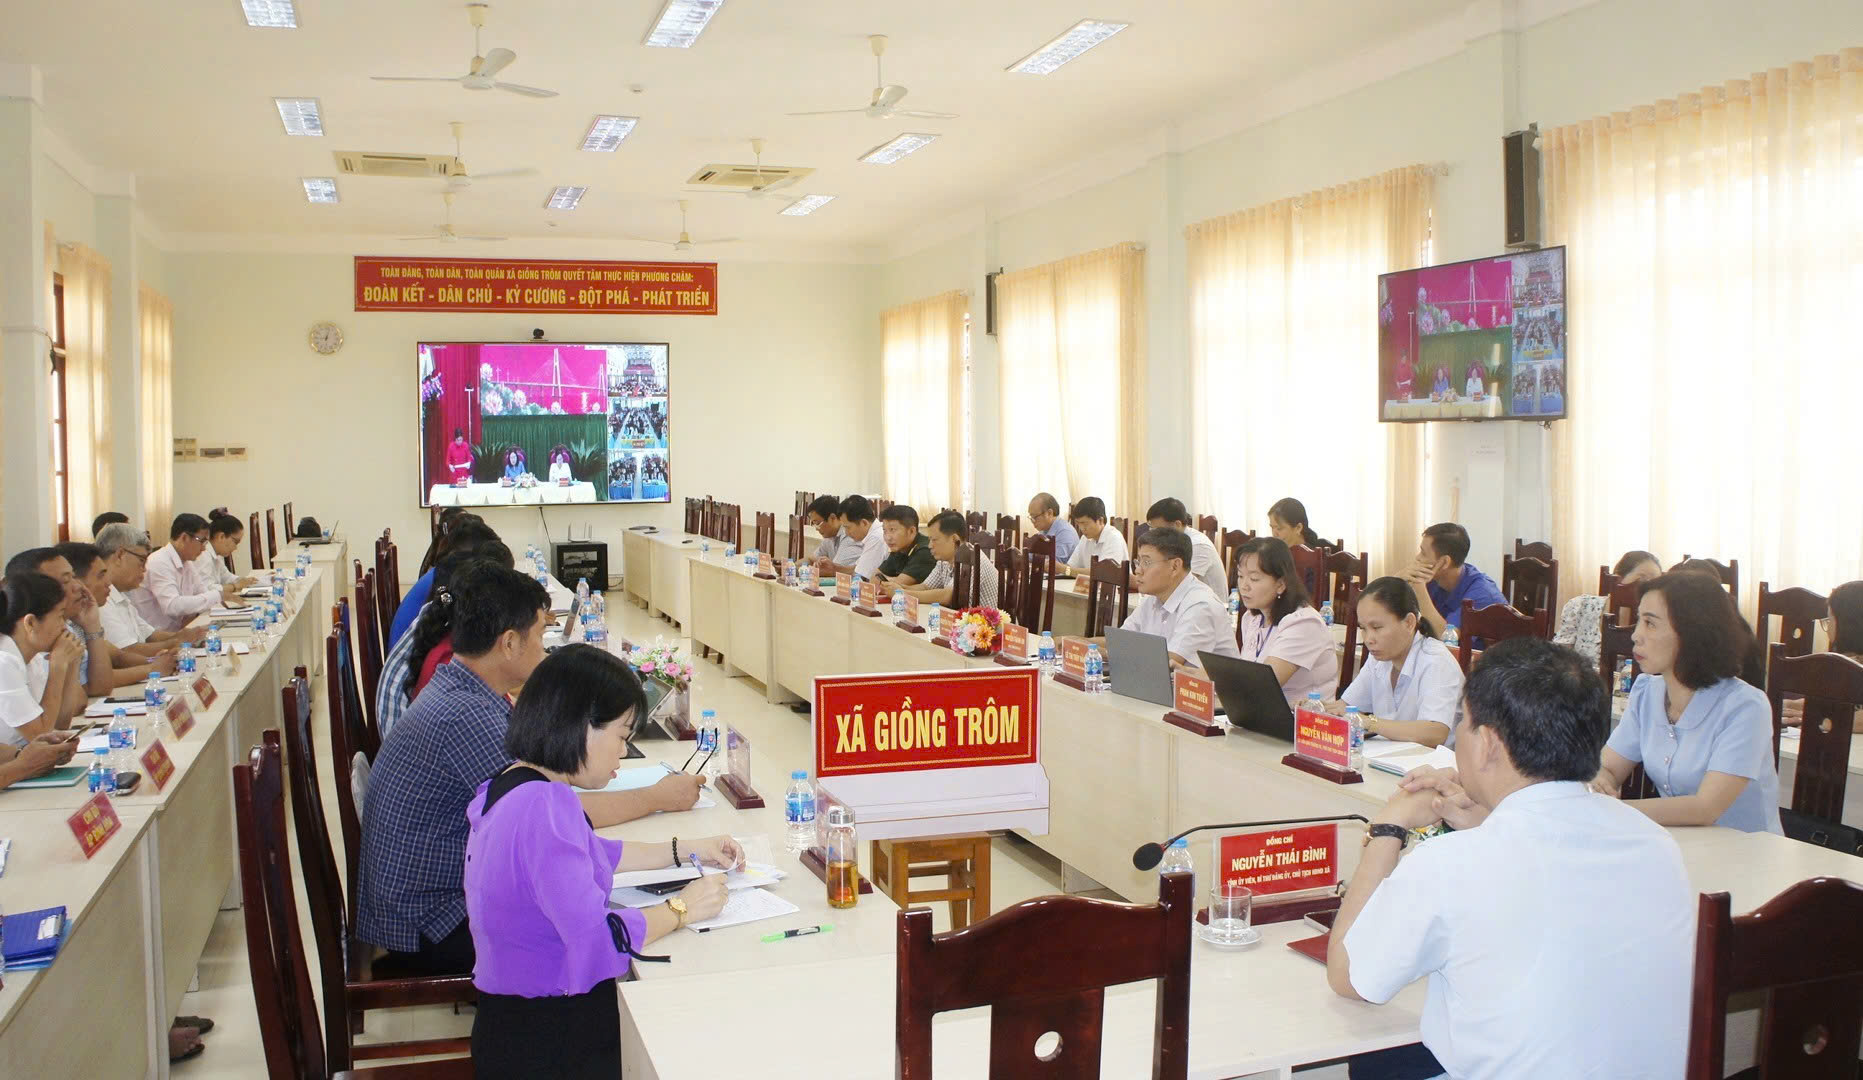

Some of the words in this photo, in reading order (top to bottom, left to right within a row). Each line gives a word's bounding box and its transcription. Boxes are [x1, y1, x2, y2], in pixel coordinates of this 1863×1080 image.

[381, 267, 400, 278] TOÀN
[426, 267, 444, 278] TOÀN
[464, 267, 483, 279] TOÀN
[485, 267, 505, 280] QUÂN
[541, 268, 561, 280] TRÔM
[562, 268, 585, 281] QUYẾT
[587, 268, 602, 281] TÂM
[603, 270, 622, 283] THỰC
[623, 269, 640, 284] HIỆN
[364, 283, 399, 303] ĐOÀN
[402, 282, 425, 302] KẾT
[438, 284, 463, 303] DÂN
[466, 283, 492, 304] CHỦ
[505, 284, 521, 304] KỶ
[524, 287, 566, 304] CƯƠNG
[578, 286, 603, 307] ĐỘT
[605, 286, 630, 305] PHÁ
[642, 286, 673, 305] PHÁT
[675, 284, 710, 306] TRIỂN
[835, 703, 867, 754] XÃ
[874, 696, 947, 752] GIỒNG
[953, 696, 1020, 746] TRÔM
[1300, 724, 1321, 740] NGUYỄN
[1266, 835, 1283, 846] ĐỒNG
[1283, 834, 1294, 844] CHÍ
[1231, 849, 1273, 872] NGUYỄN
[1275, 848, 1300, 866] THÁI
[1302, 846, 1327, 863] BÌNH
